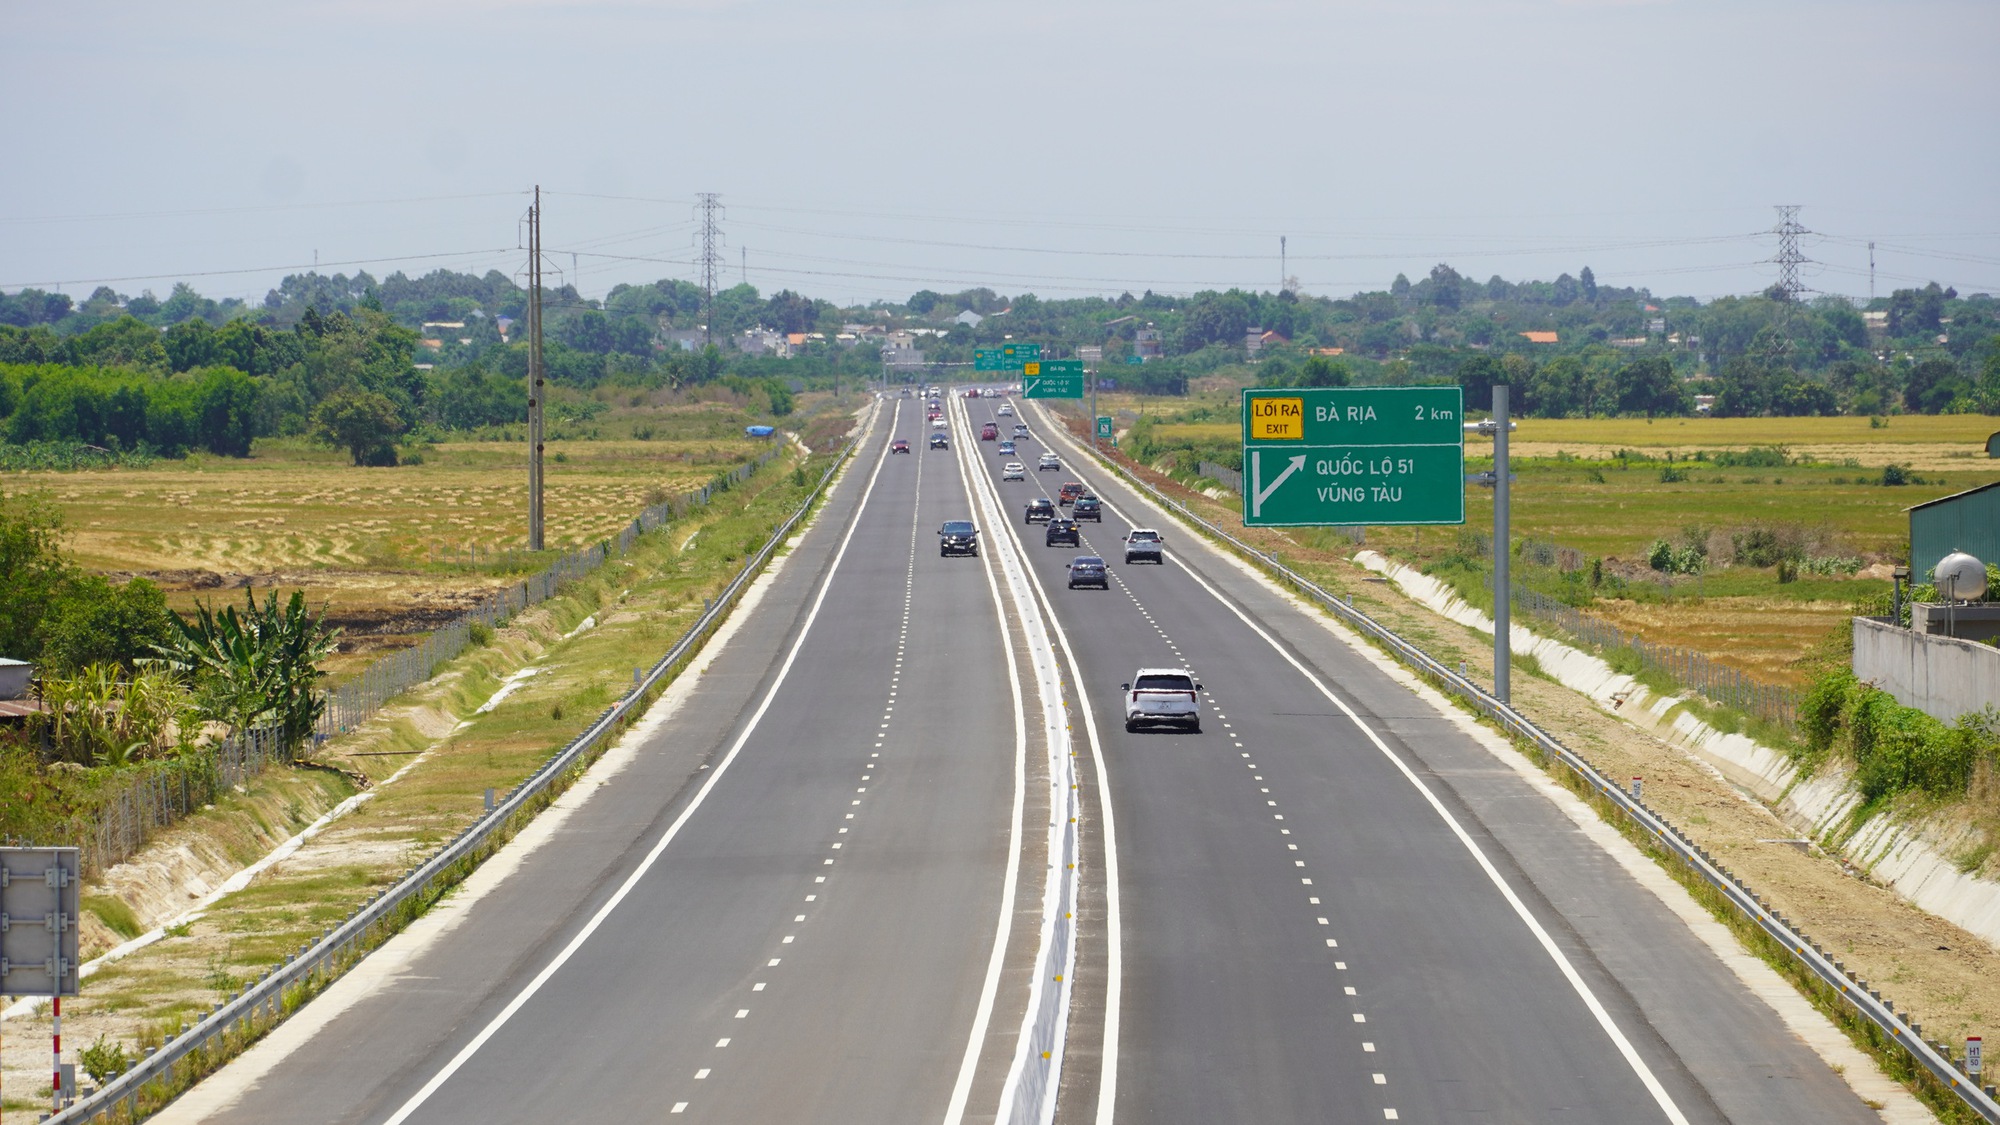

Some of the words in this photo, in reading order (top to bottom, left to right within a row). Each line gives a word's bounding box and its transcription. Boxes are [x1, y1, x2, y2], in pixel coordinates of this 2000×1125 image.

[1255, 400, 1277, 417] LỐI
[1281, 404, 1300, 417] RA
[1316, 402, 1340, 422] BÀ
[1347, 406, 1377, 425] RỊA
[1414, 405, 1424, 421] 2
[1431, 407, 1453, 421] km
[1266, 424, 1289, 435] EXIT
[1316, 452, 1364, 475] QUỐC
[1370, 456, 1393, 478] LỘ
[1398, 459, 1414, 474] 51
[1317, 482, 1365, 503] VŨNG
[1370, 482, 1402, 503] TÀU
[1969, 1047, 1980, 1055] H1
[1970, 1059, 1979, 1067] 50
